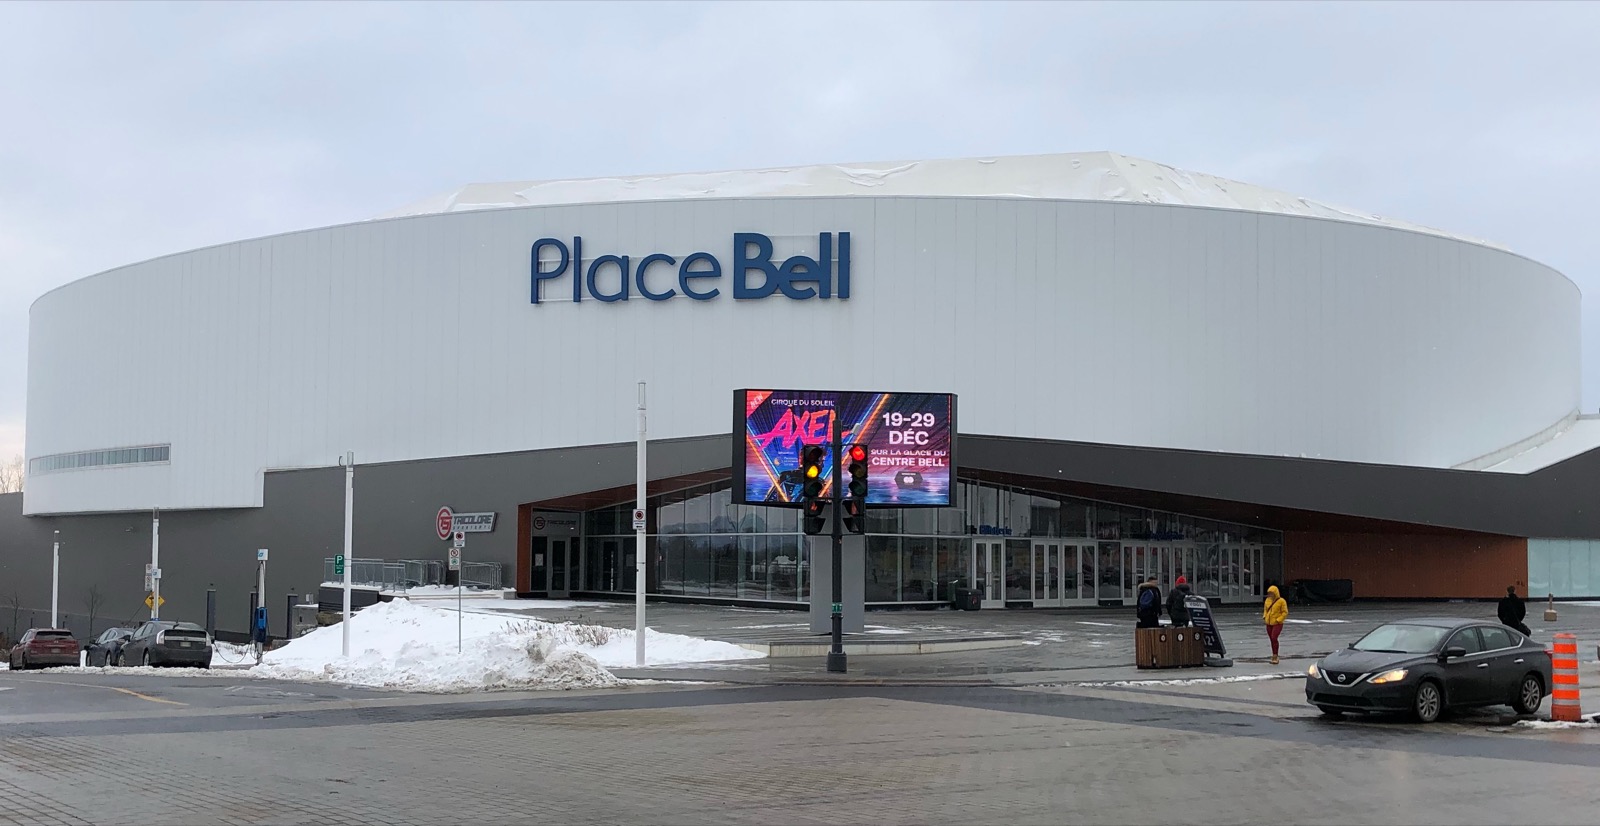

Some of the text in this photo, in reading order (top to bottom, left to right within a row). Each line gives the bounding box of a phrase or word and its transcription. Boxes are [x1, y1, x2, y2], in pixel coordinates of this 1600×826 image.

[530, 231, 851, 304] Place Bell
[771, 399, 798, 407] CIRQUE
[882, 411, 935, 427] 19-29
[889, 428, 930, 446] DÉC
[871, 457, 945, 467] CENTRE BELL
